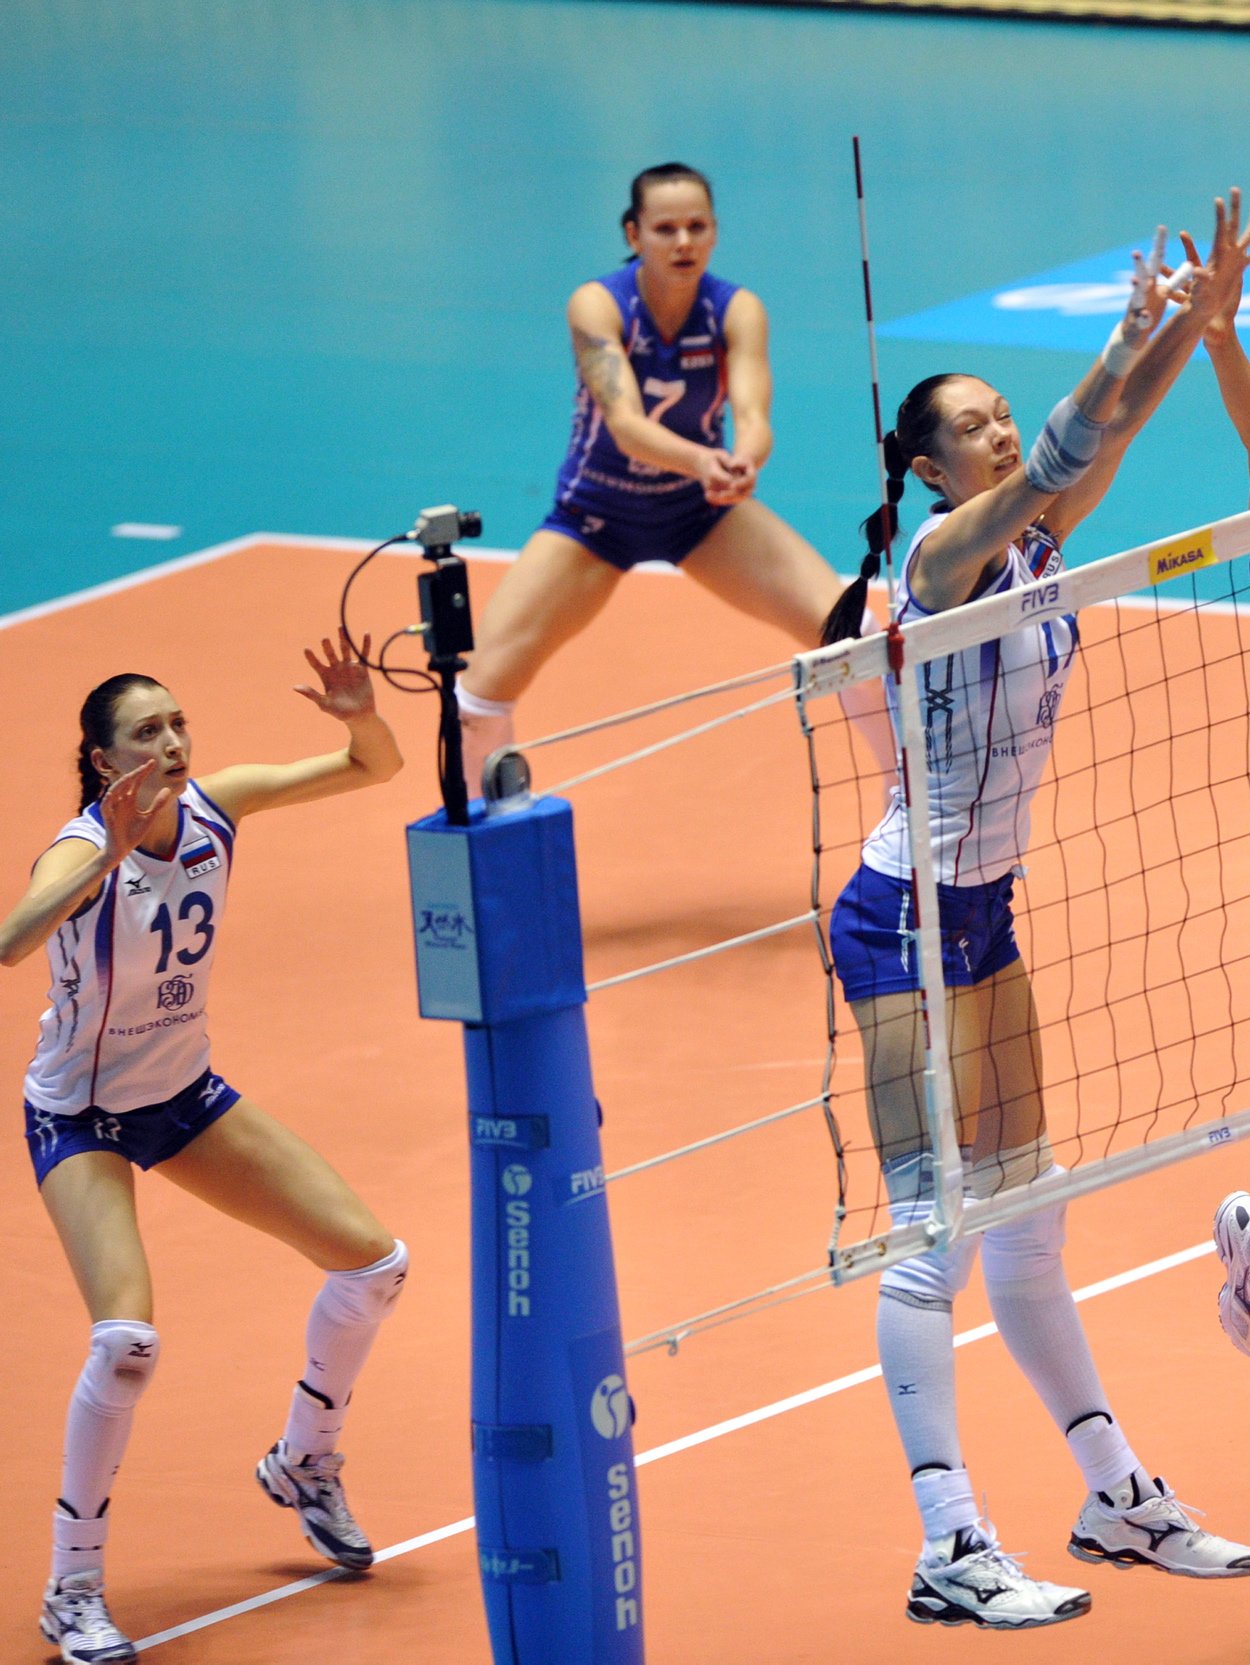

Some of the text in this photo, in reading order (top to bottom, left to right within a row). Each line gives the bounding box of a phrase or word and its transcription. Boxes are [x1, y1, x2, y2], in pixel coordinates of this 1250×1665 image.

[1021, 583, 1060, 612] FIVB
[192, 860, 217, 875] RUS
[150, 890, 215, 974] 13
